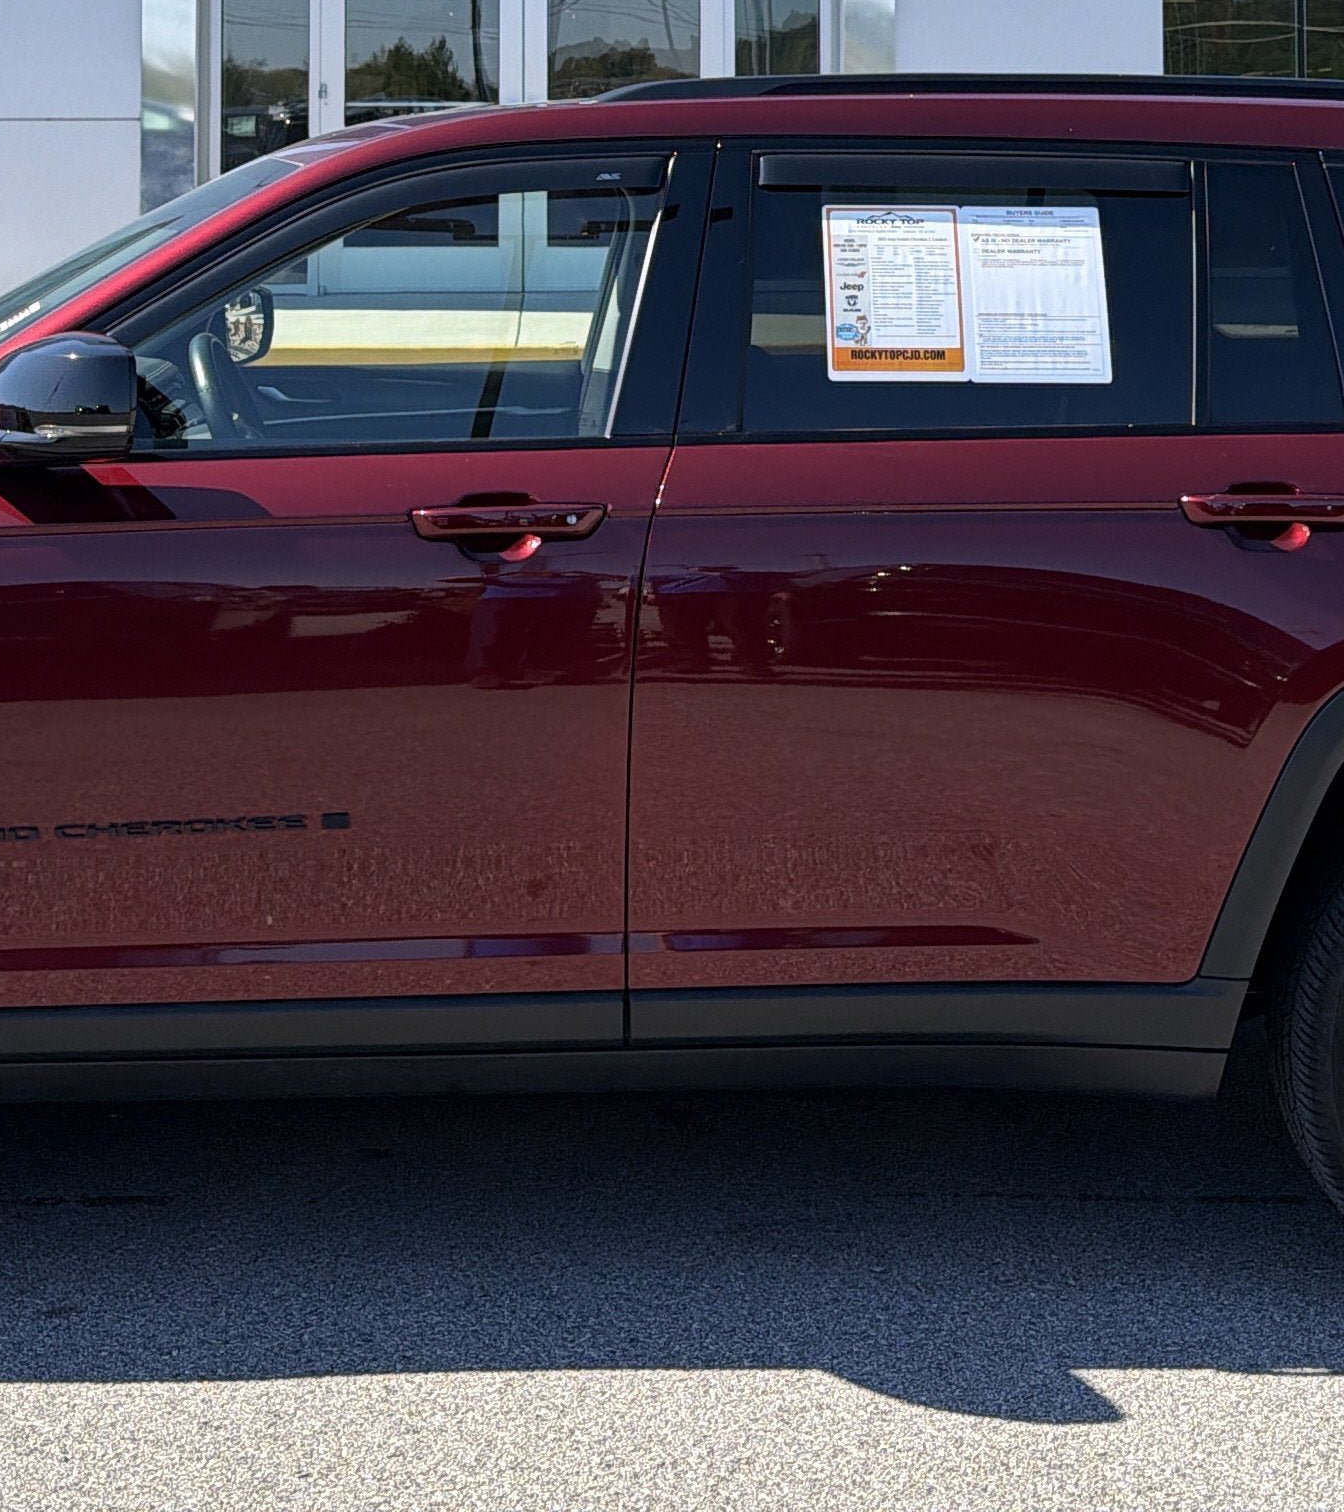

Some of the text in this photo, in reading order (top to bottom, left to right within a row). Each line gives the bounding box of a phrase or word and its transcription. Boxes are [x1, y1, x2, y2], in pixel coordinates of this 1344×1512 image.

[839, 282, 864, 291] Jeep
[851, 350, 946, 361] ROCKYTOPCJD.COM
[54, 813, 309, 840] CHEROKEE
